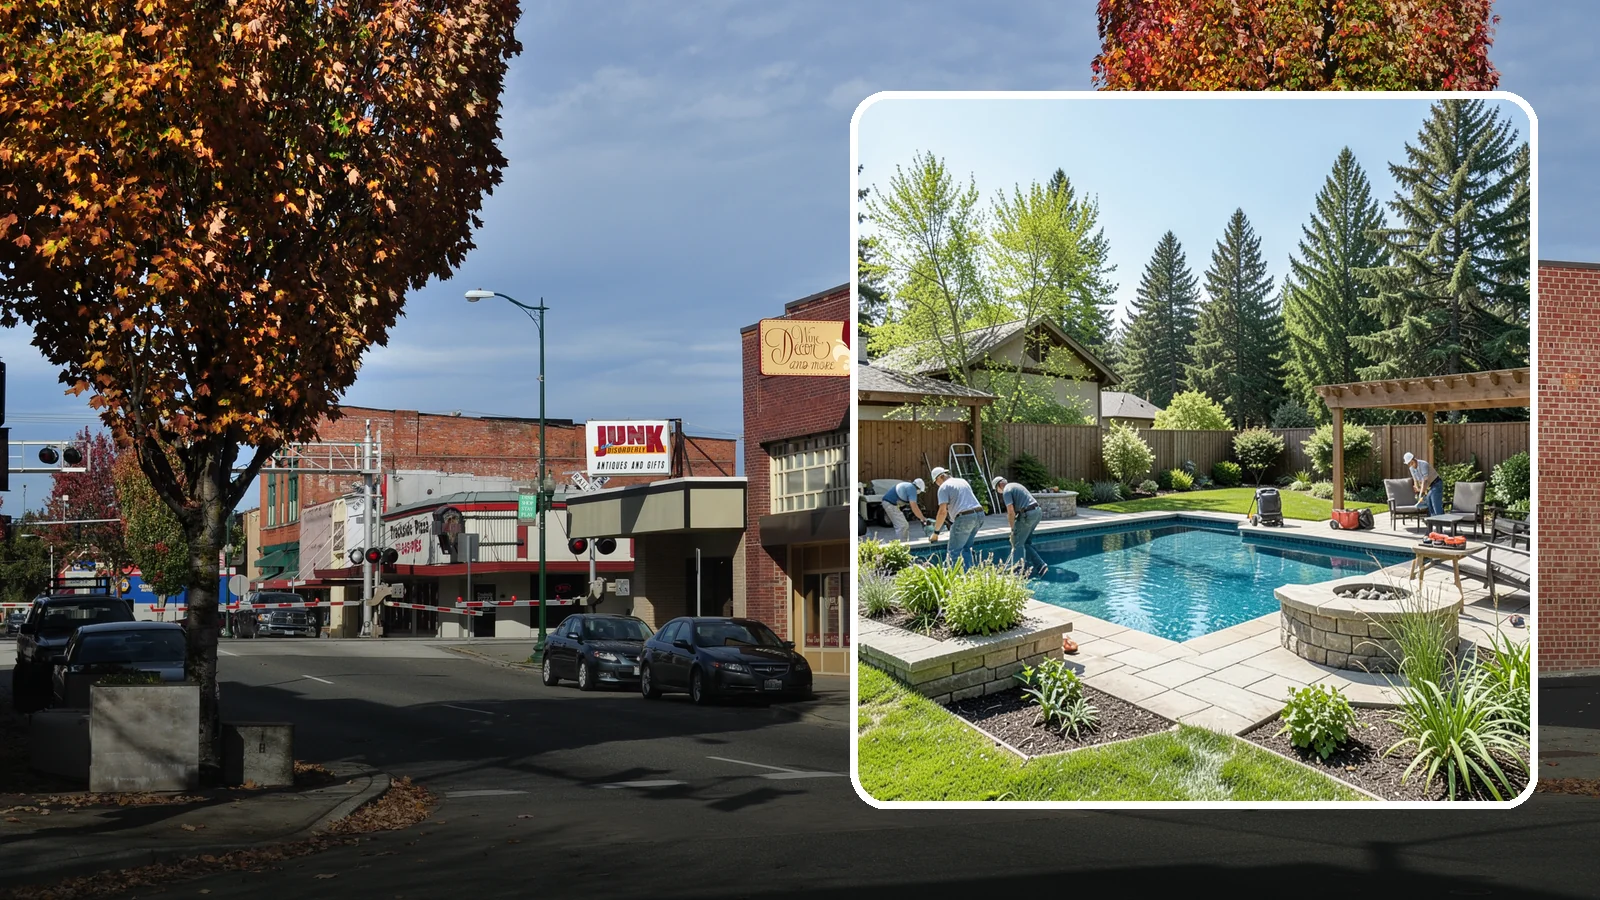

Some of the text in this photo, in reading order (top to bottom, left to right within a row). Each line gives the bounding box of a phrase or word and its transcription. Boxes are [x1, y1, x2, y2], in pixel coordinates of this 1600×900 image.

[596, 425, 664, 457] JUNK
[597, 461, 665, 470] ANTIQUES AND GIFTS
[390, 519, 429, 539] Trackside Pizza
